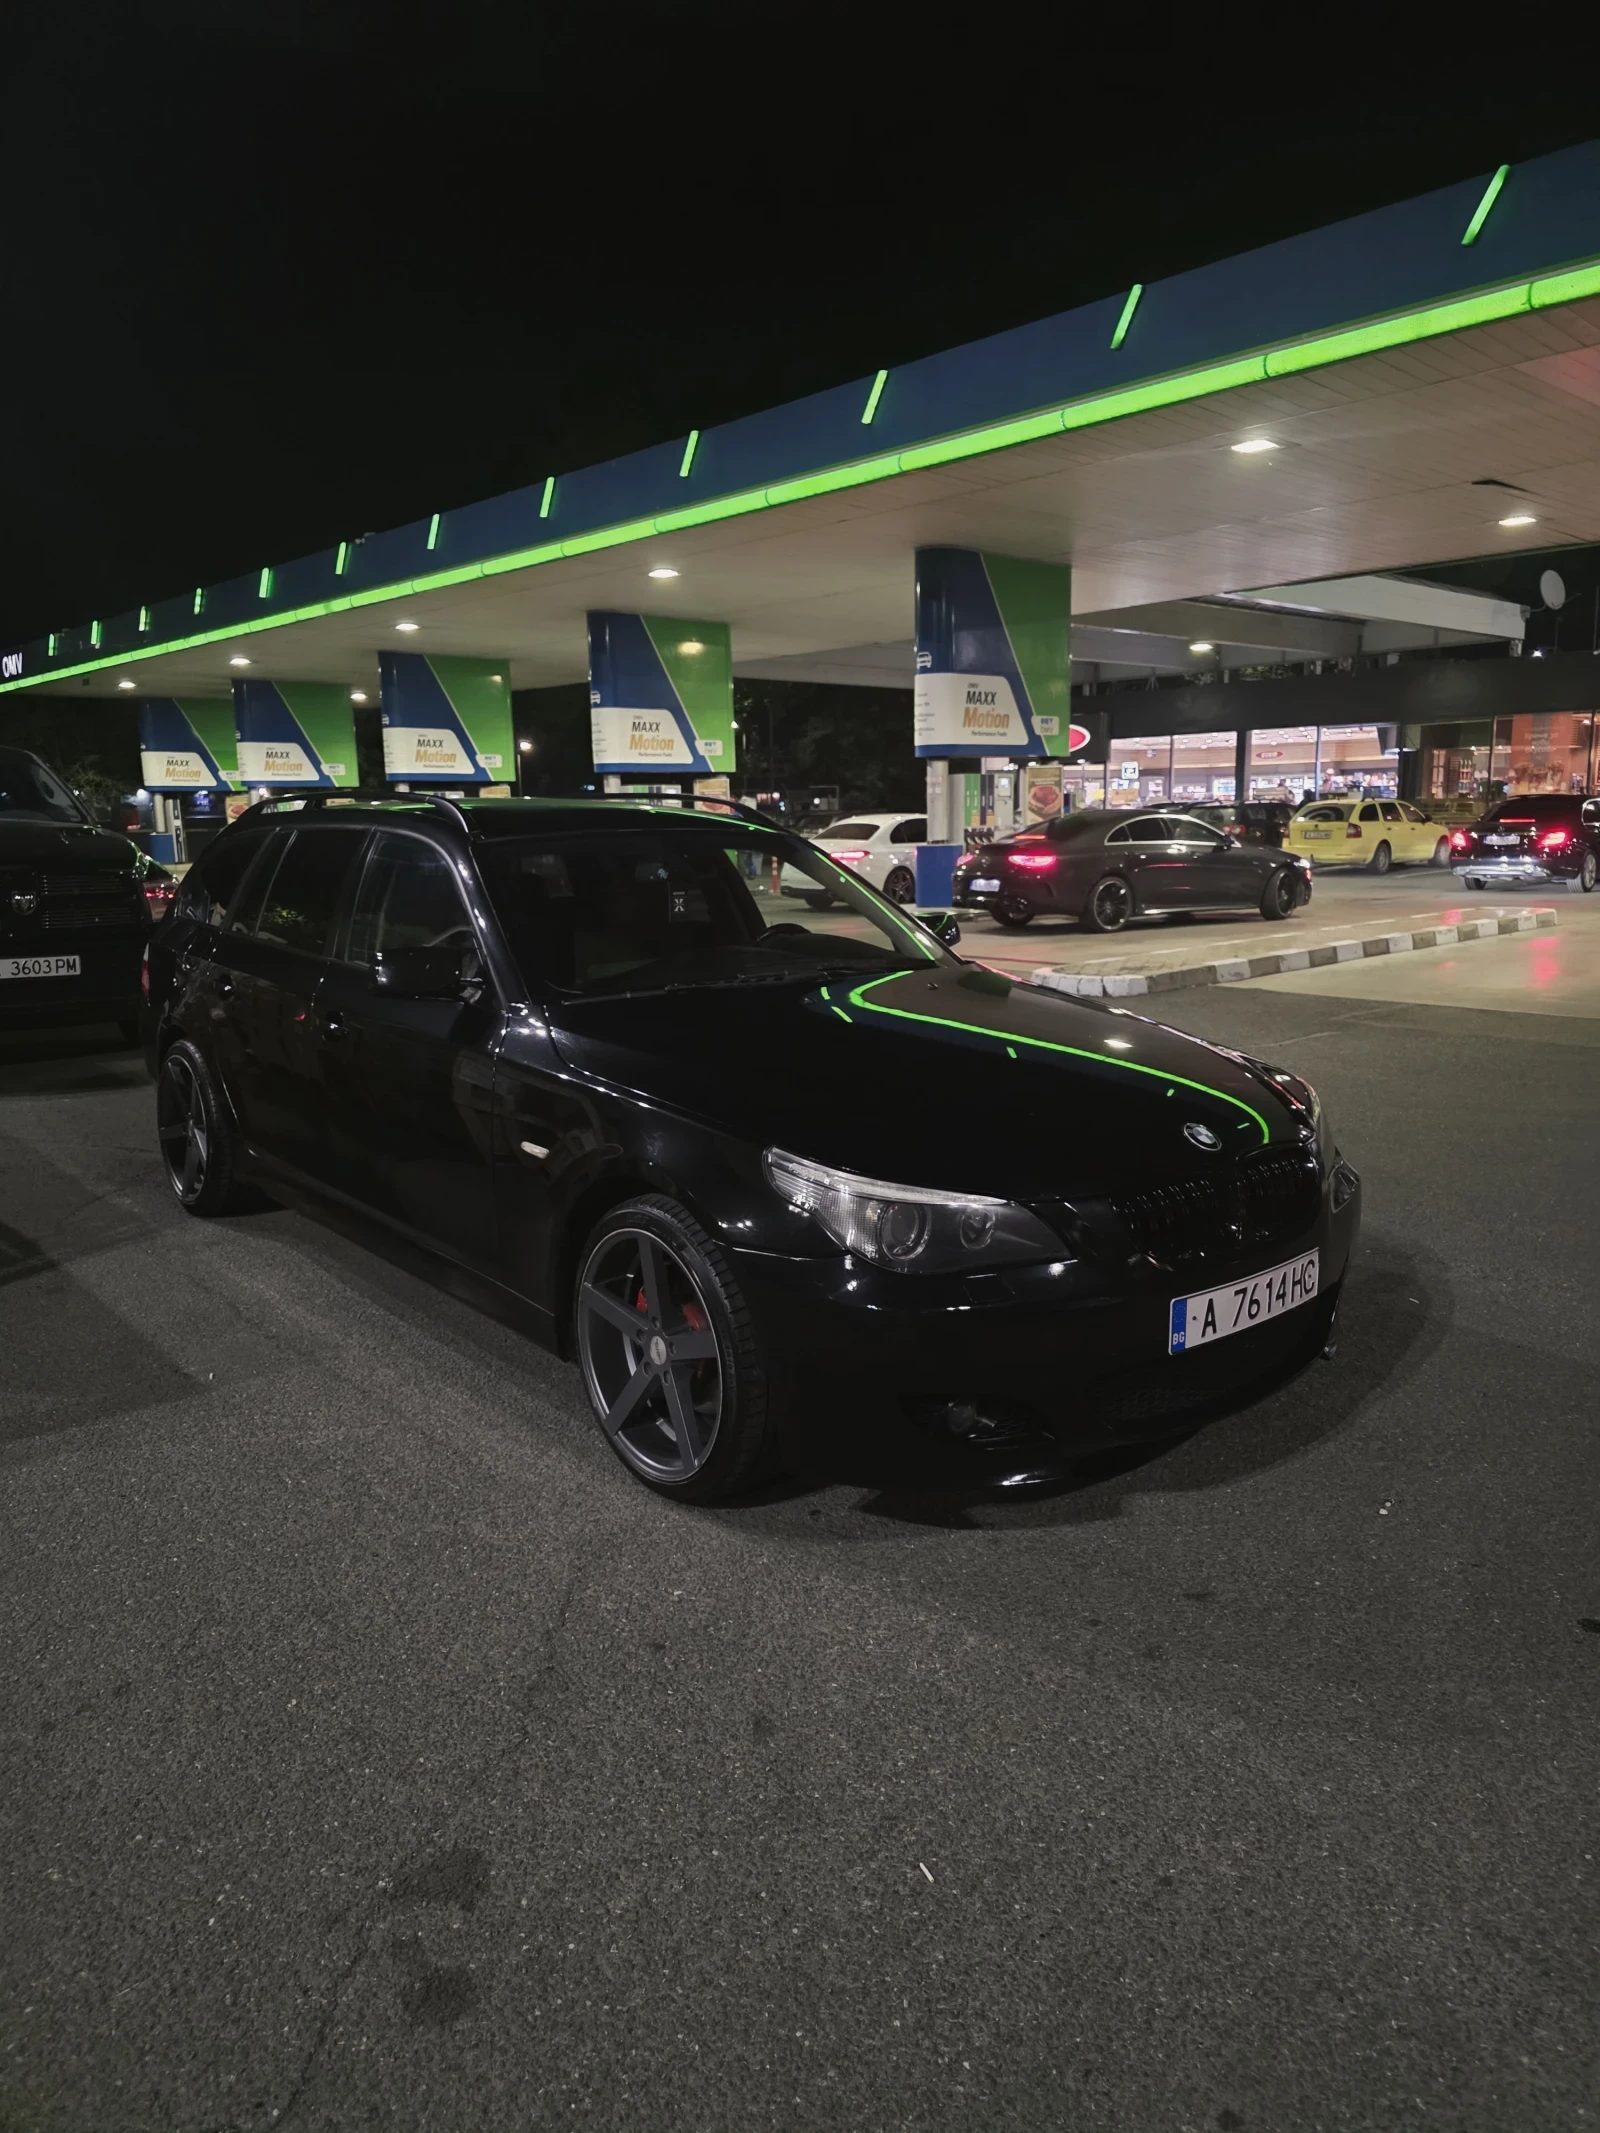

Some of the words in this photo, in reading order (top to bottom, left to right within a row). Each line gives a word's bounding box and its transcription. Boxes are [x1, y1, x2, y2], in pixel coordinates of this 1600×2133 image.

[2, 652, 23, 678] OMV
[966, 690, 997, 705] MAXX
[962, 707, 1010, 729] Motion
[631, 721, 661, 733] MAXX
[417, 738, 444, 749] MAXX
[629, 734, 675, 752] Motion
[166, 759, 190, 767] MAXX
[265, 751, 291, 760] MAXX
[415, 749, 457, 764] Motion
[165, 767, 202, 779] Motion
[264, 760, 303, 772] Motion
[1201, 1298, 1217, 1338] A
[1172, 1331, 1186, 1346] BG
